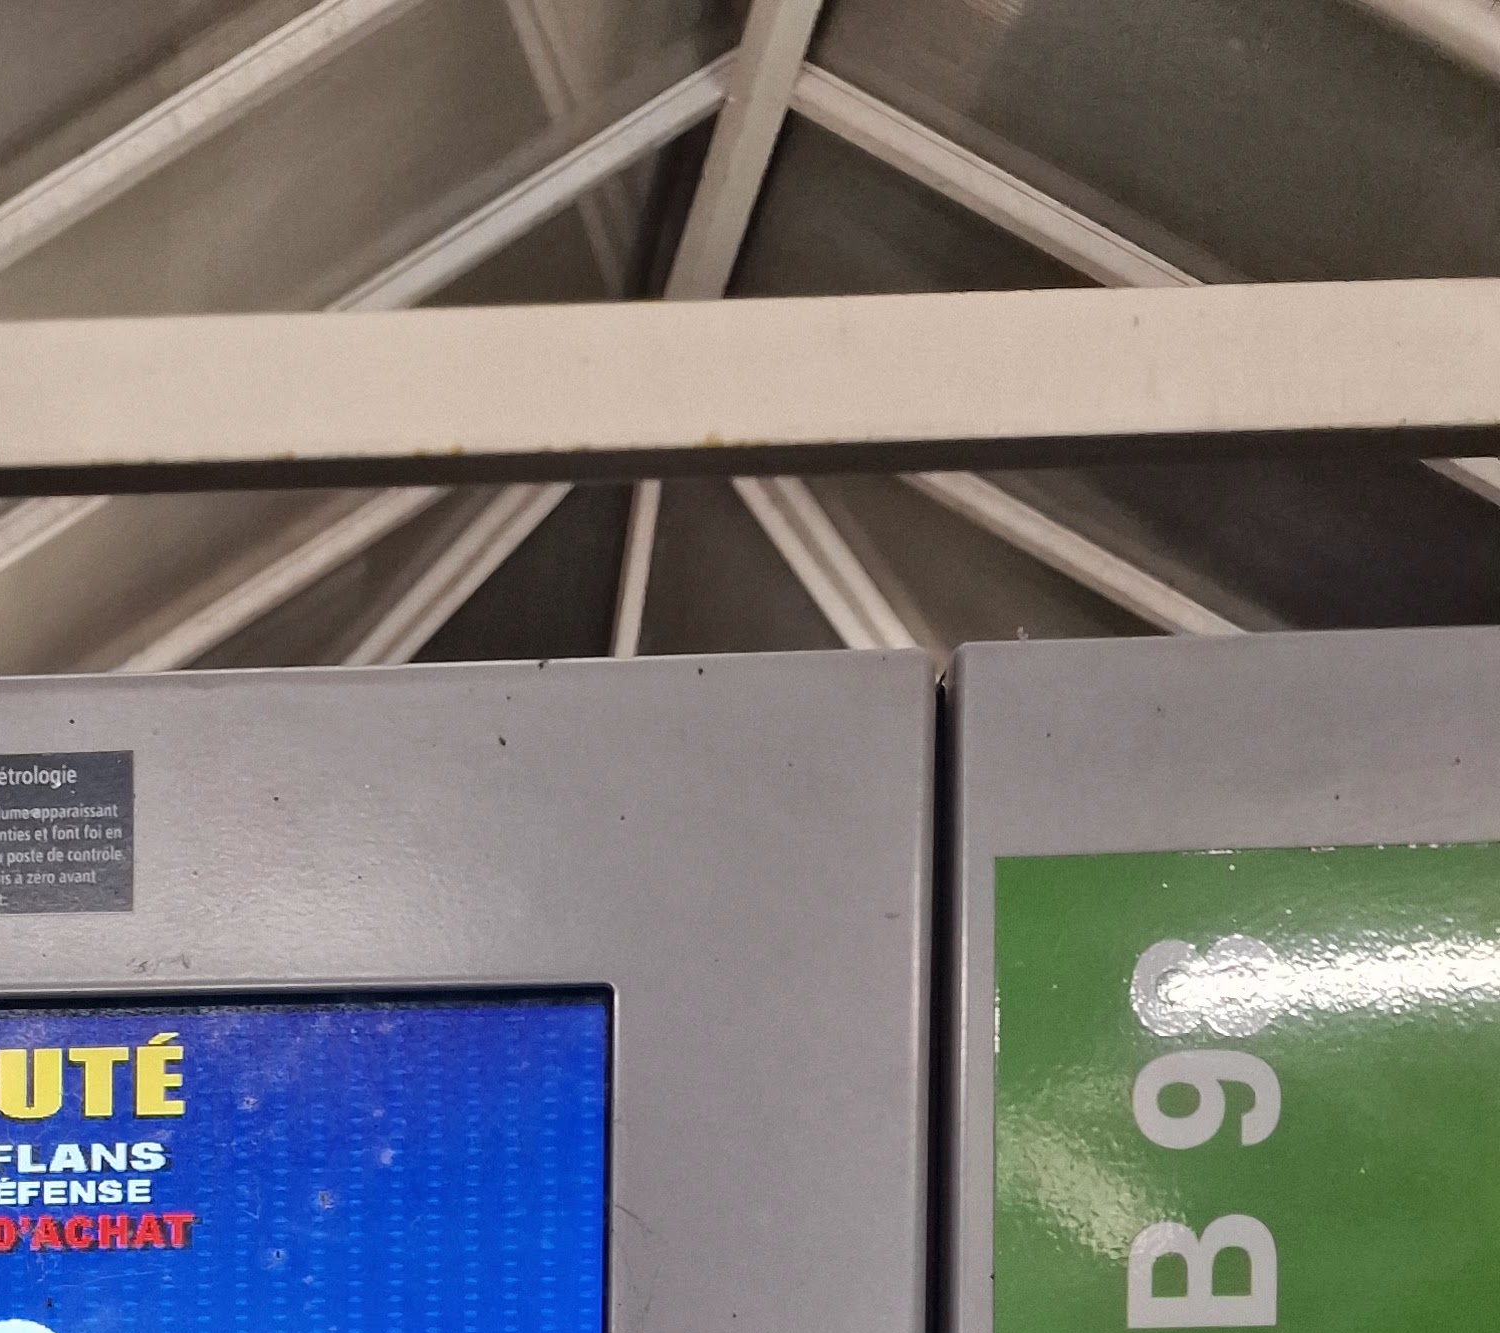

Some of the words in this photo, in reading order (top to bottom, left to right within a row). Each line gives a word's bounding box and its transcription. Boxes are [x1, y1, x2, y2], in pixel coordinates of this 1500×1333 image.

[30, 803, 118, 821] apparaissant
[34, 828, 48, 841] et
[52, 825, 79, 840] font
[84, 824, 101, 839] foi
[105, 827, 122, 839] en
[7, 849, 43, 867] poste
[47, 847, 63, 861] de
[59, 870, 97, 883] avant
[1130, 933, 1283, 1150] 98
